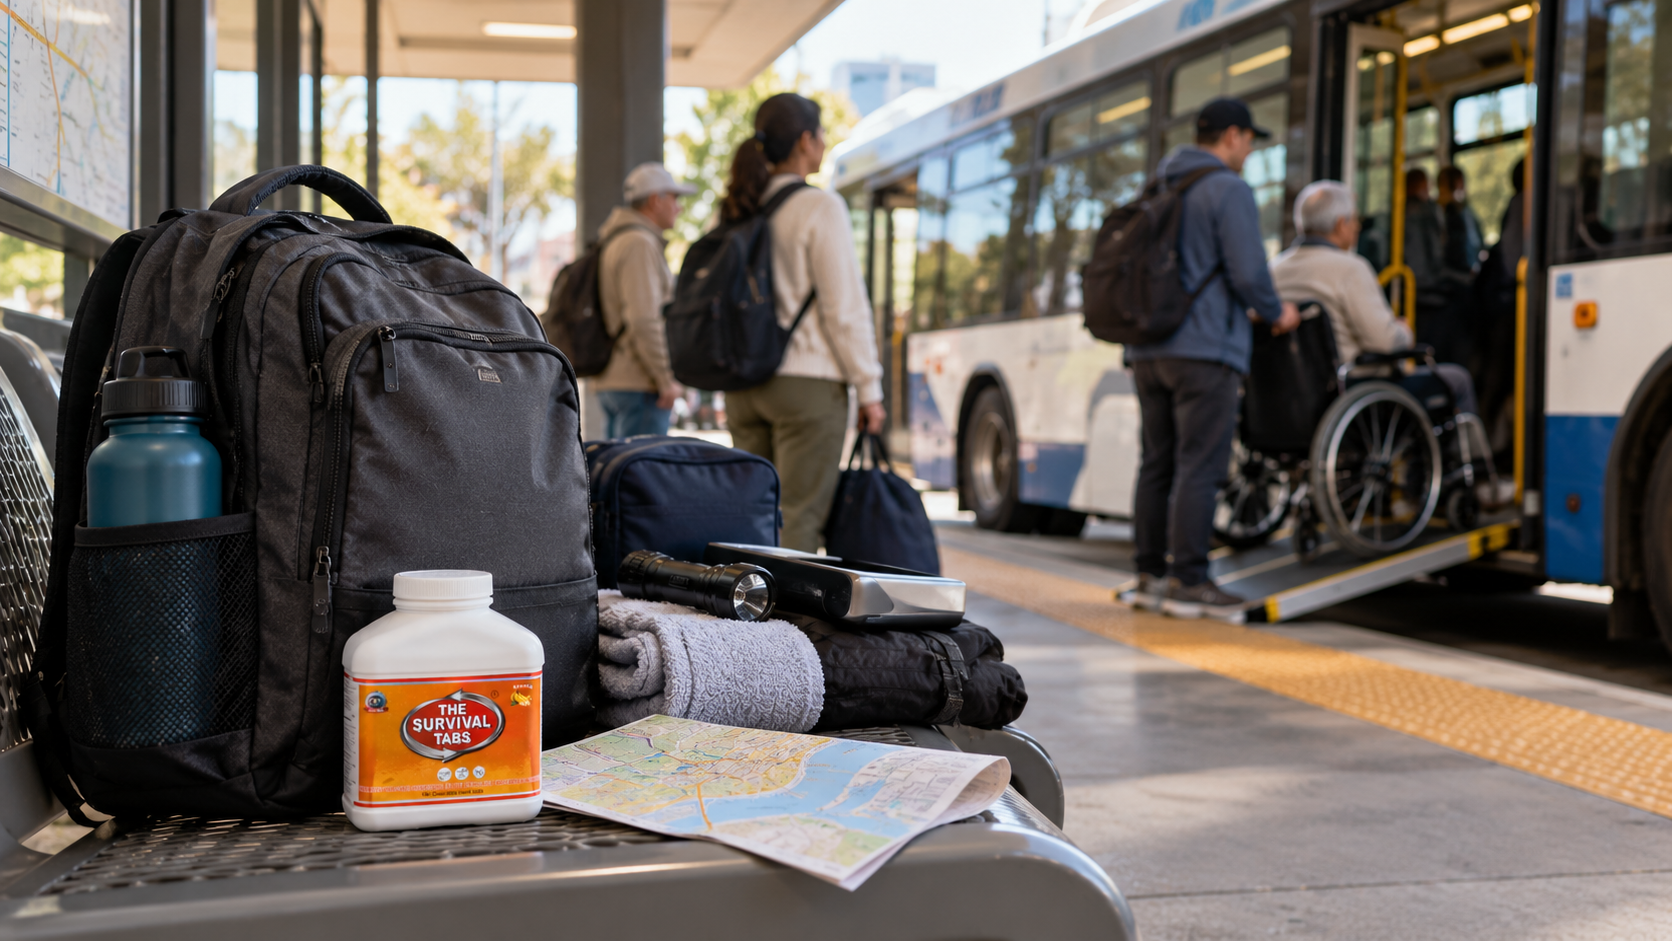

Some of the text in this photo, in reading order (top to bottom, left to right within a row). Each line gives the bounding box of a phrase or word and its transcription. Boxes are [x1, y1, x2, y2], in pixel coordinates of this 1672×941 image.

[438, 703, 467, 715] THE
[412, 715, 491, 732] SURVIVAL
[434, 732, 471, 745] TABS
